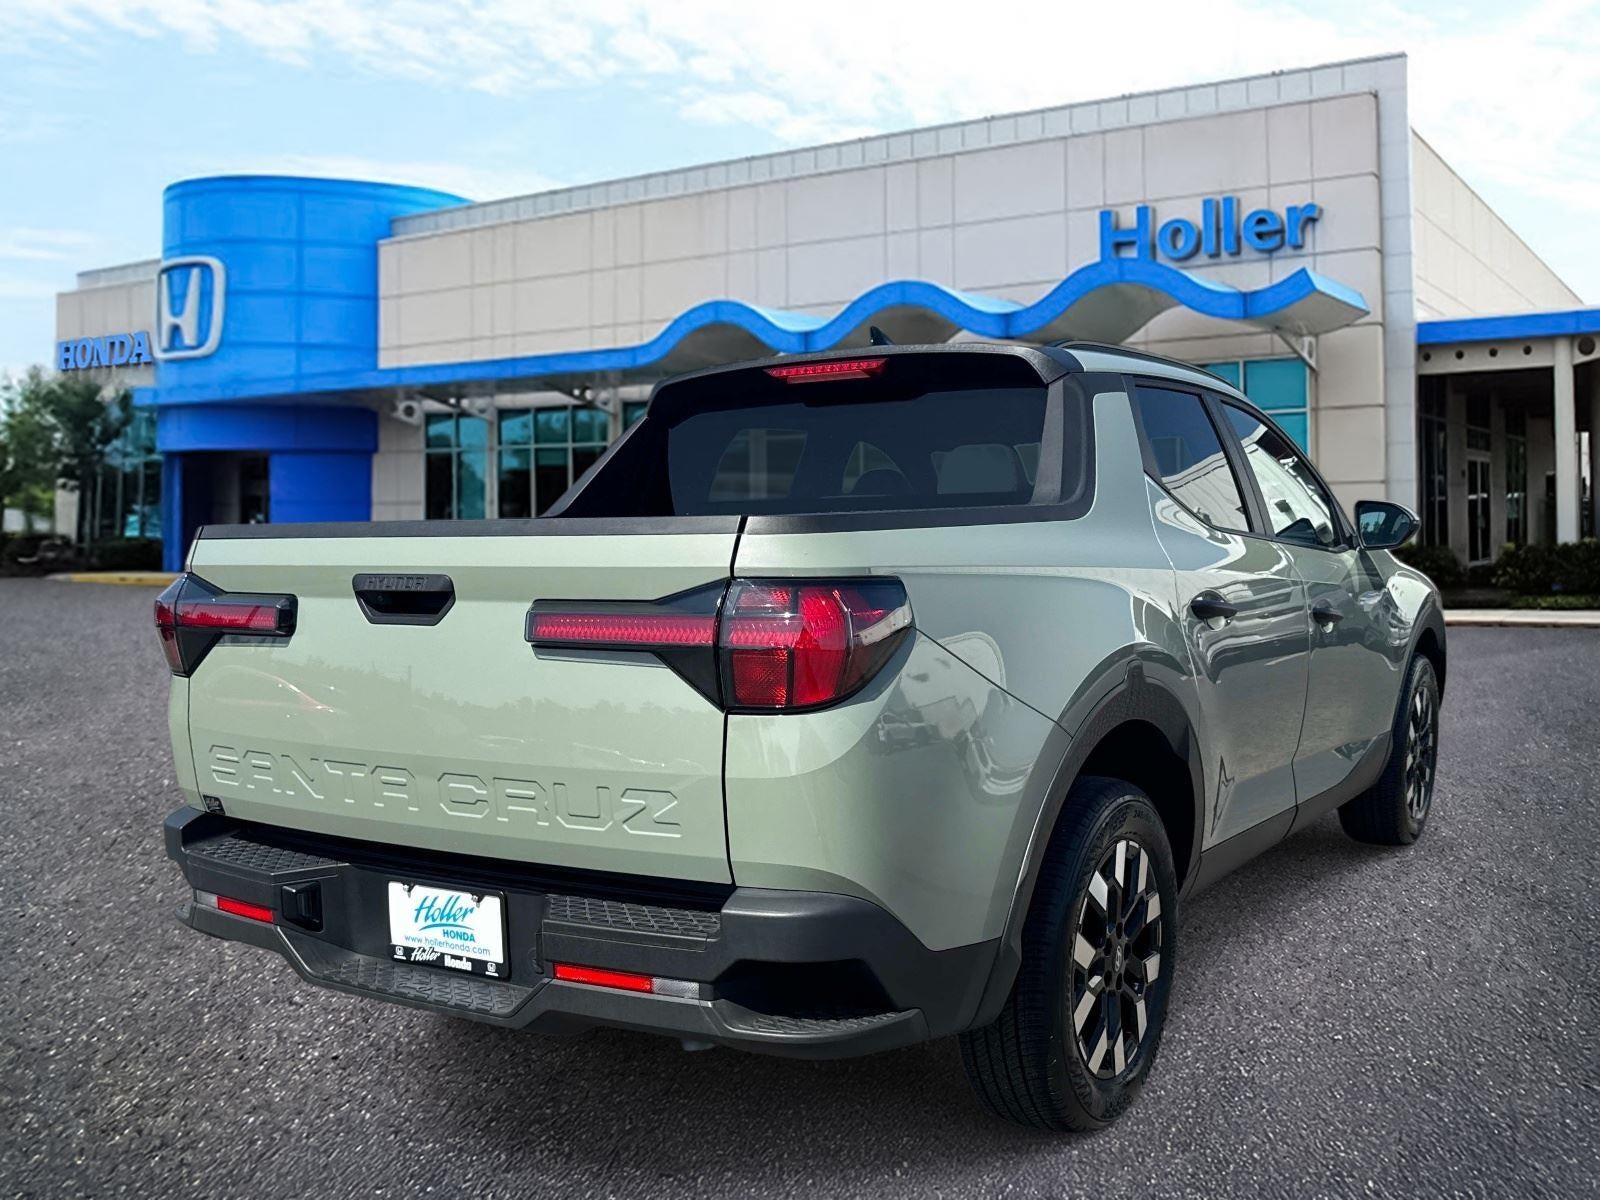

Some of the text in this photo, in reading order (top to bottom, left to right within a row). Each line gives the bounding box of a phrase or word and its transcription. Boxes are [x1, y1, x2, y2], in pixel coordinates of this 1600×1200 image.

[1099, 195, 1322, 262] Holler
[57, 331, 153, 371] HONDA
[208, 744, 682, 838] SANTA CRUZ
[414, 895, 475, 923] Holler
[404, 934, 491, 957] www.hollerhonda.com
[442, 929, 476, 943] HONDA
[410, 946, 472, 971] Holler Honda
